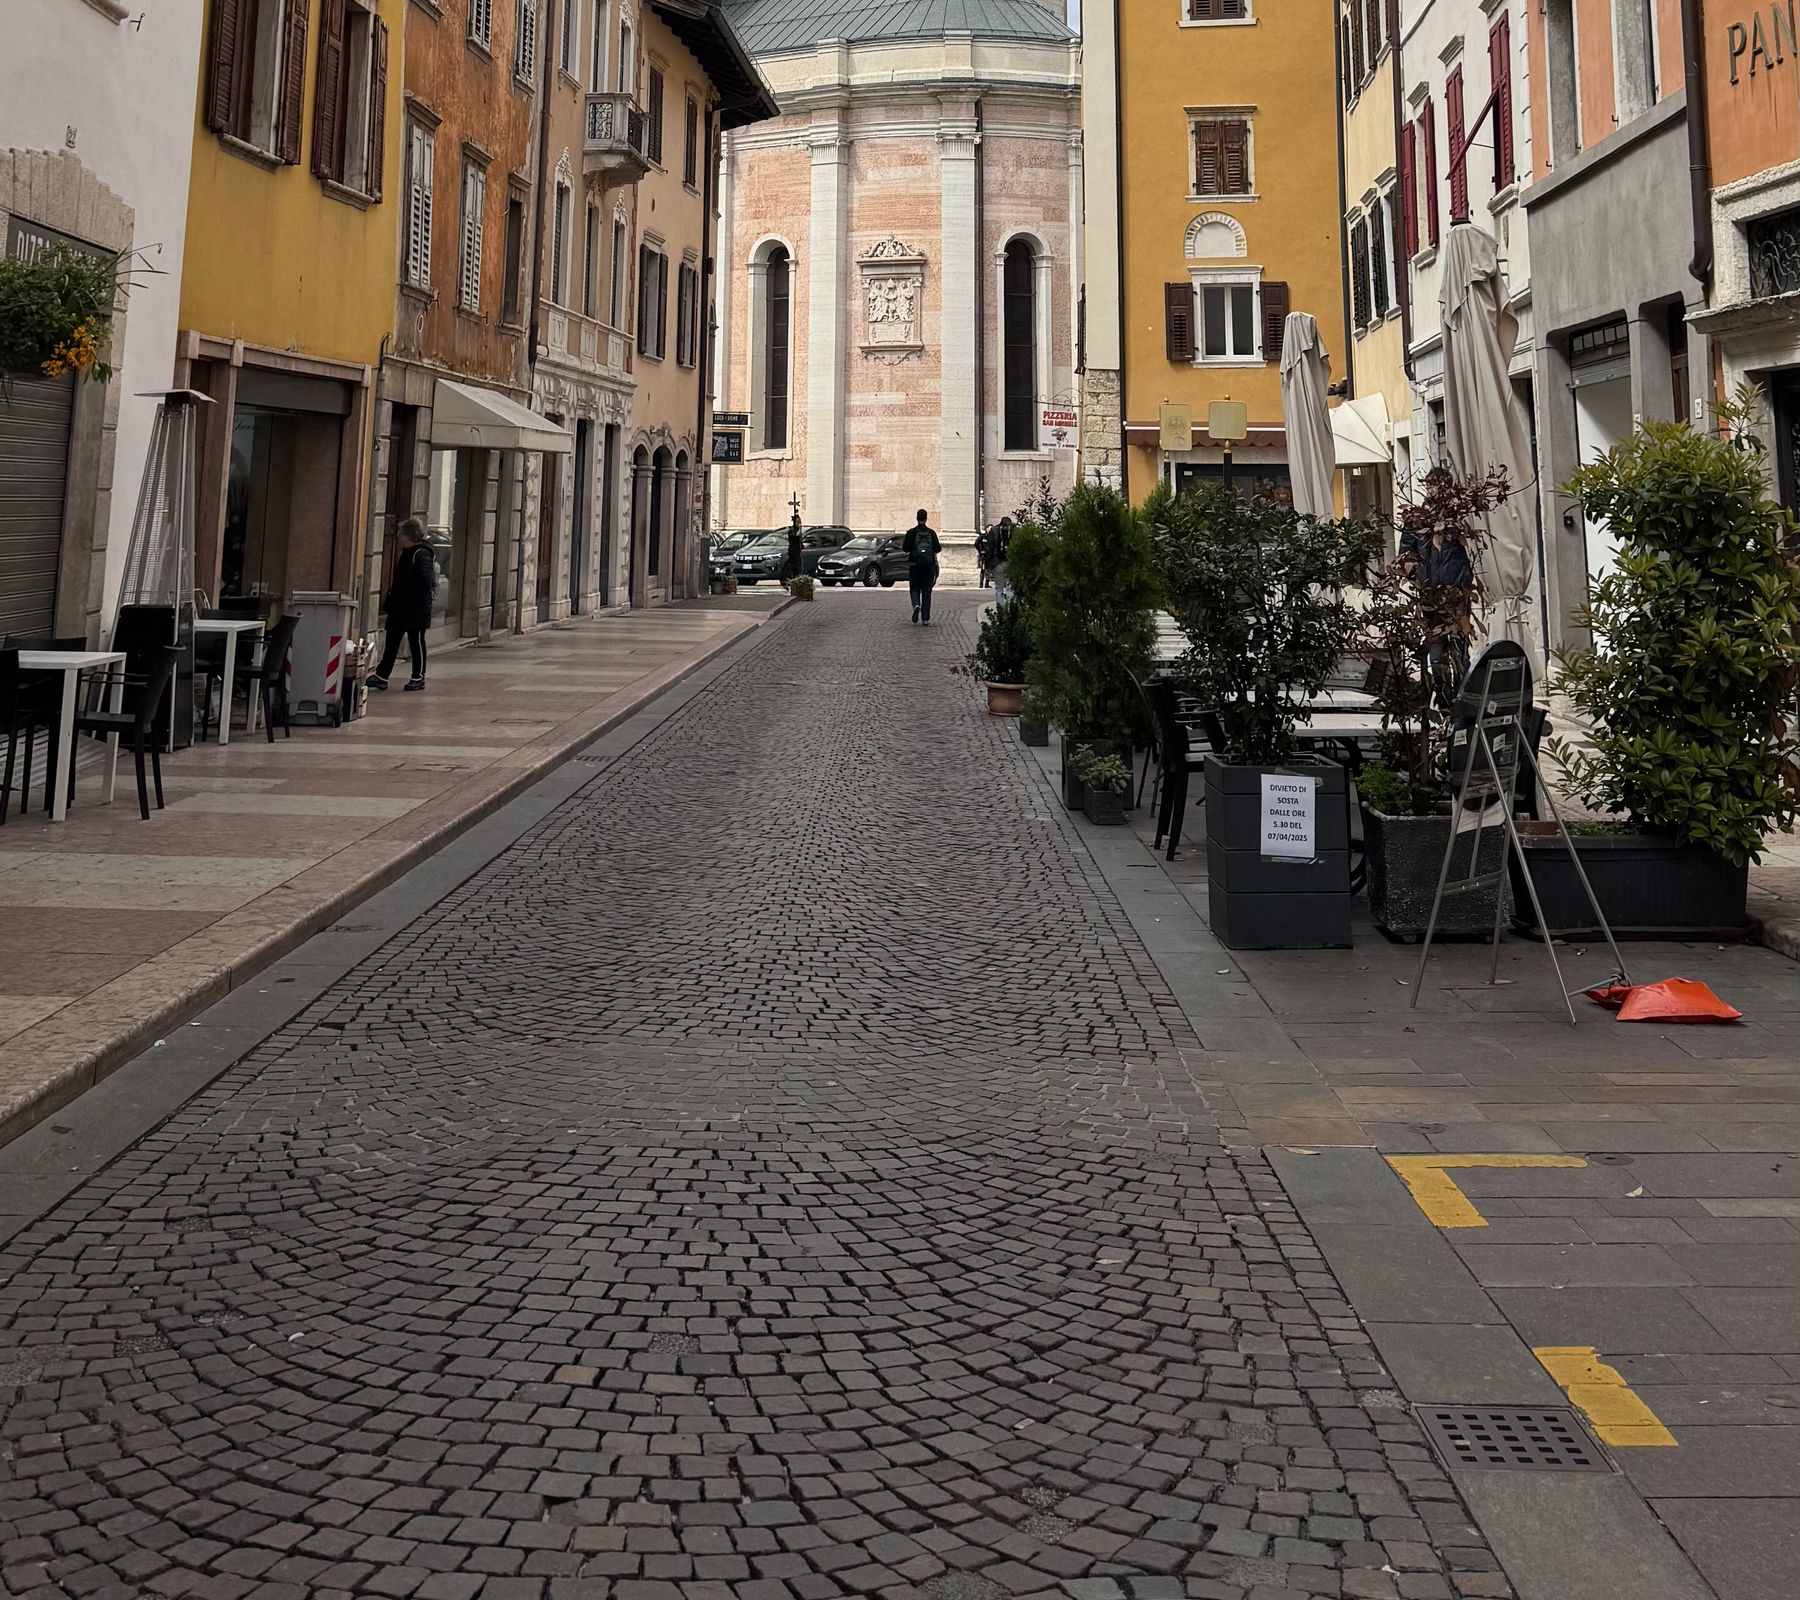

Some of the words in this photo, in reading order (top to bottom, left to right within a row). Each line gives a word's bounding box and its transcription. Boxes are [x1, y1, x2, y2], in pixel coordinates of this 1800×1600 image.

[1043, 411, 1077, 420] PIZZERIA
[1270, 784, 1297, 792] DIVIETO
[1277, 797, 1299, 805] SOSTA
[1270, 809, 1290, 817] DALLE
[1291, 810, 1306, 818] ORE
[1273, 821, 1288, 829] 5.30
[1267, 833, 1307, 841] 07/04/2025
